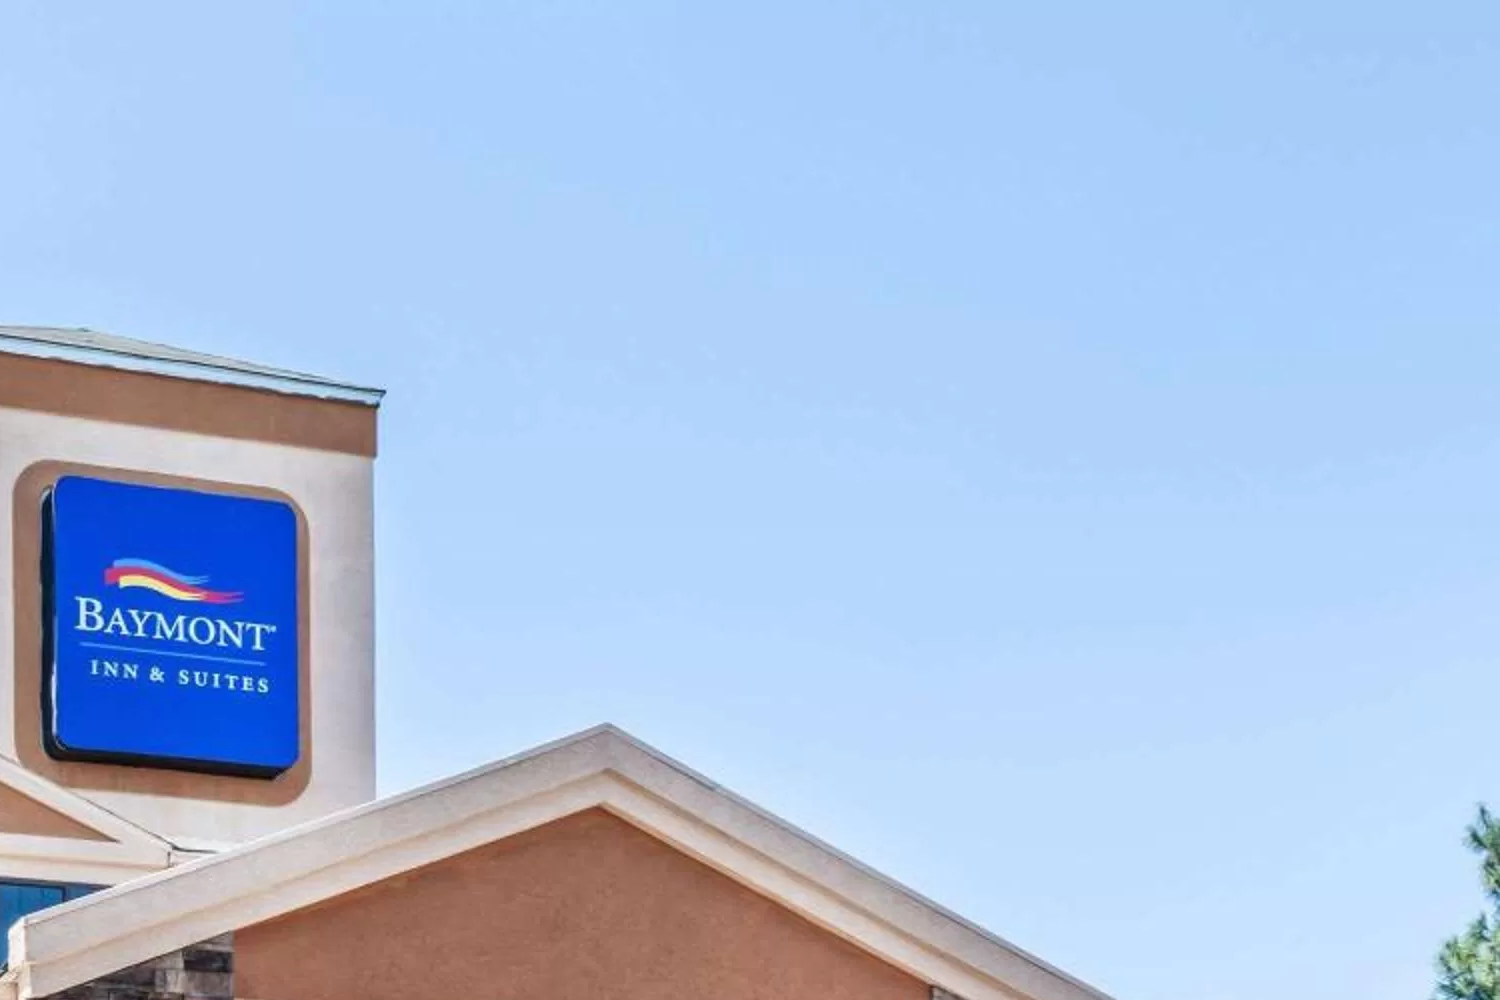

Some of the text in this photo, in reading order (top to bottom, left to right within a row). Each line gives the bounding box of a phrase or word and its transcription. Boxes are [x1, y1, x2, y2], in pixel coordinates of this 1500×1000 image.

[74, 596, 274, 651] BAYMONT
[90, 659, 269, 693] INN & SUITES
